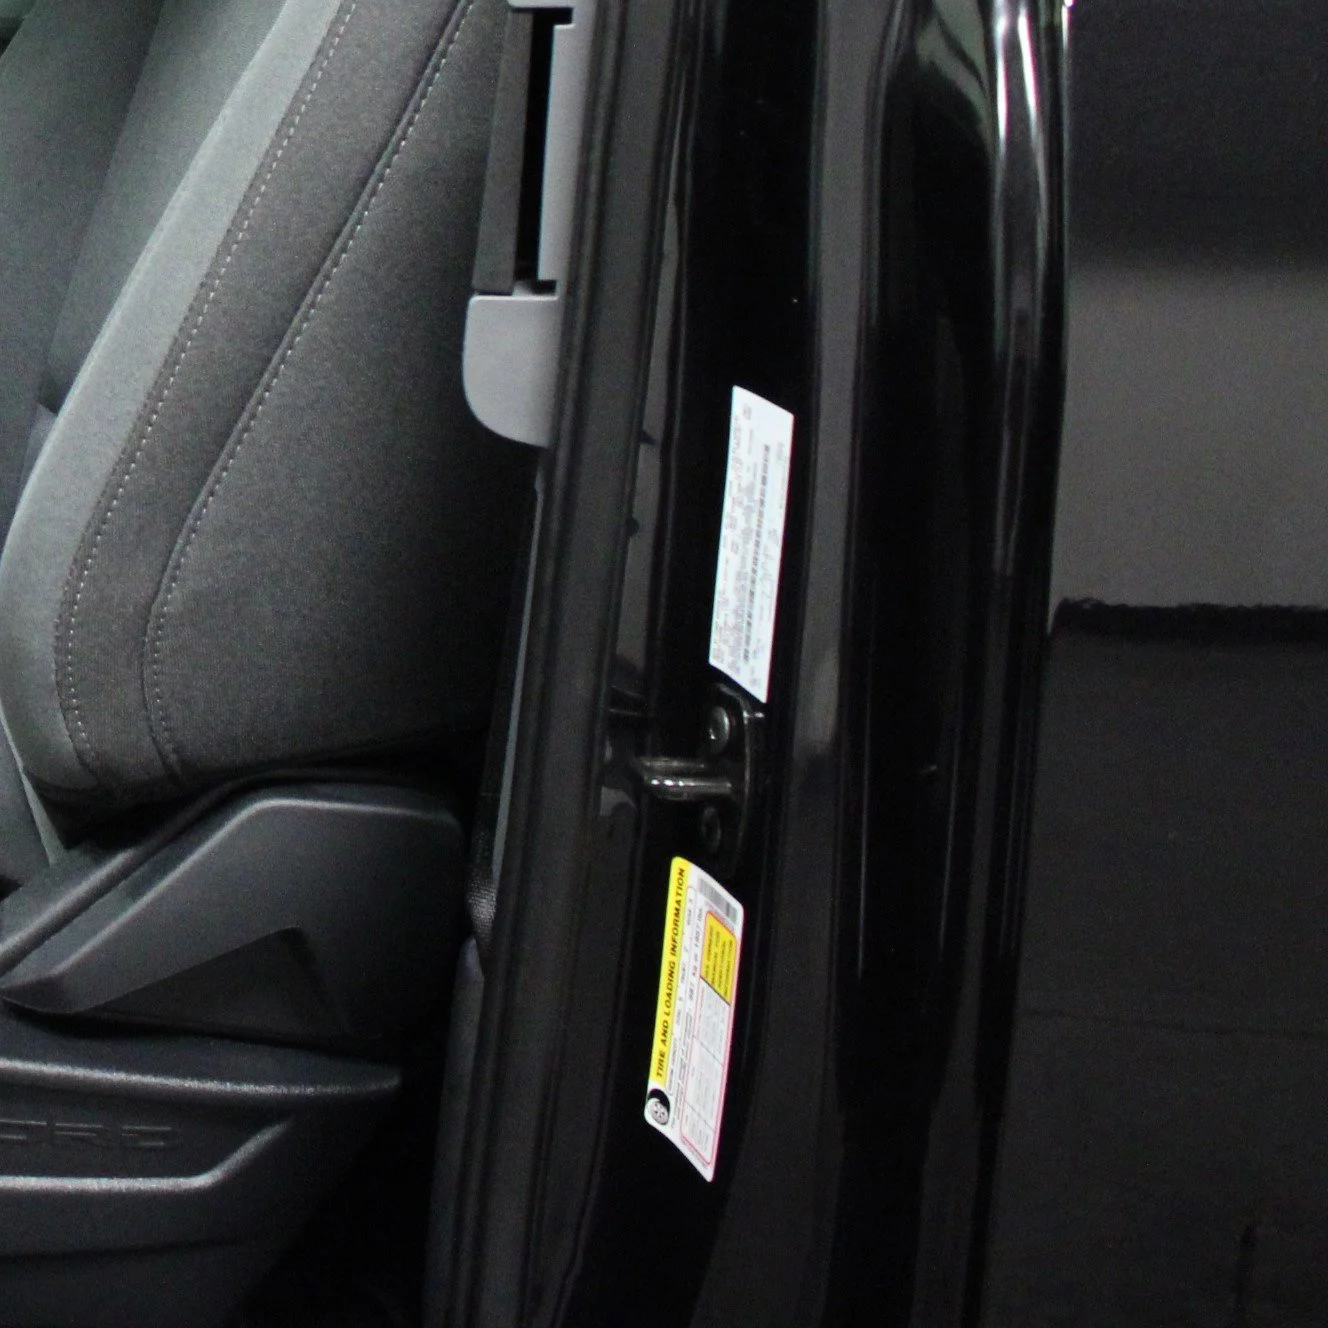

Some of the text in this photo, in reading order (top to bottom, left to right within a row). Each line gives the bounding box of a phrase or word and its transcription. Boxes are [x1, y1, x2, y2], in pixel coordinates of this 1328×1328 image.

[670, 867, 685, 957] INFORMATION
[664, 960, 676, 1016] LOADING
[660, 1020, 669, 1046] AND
[656, 1051, 665, 1078] TIRE
